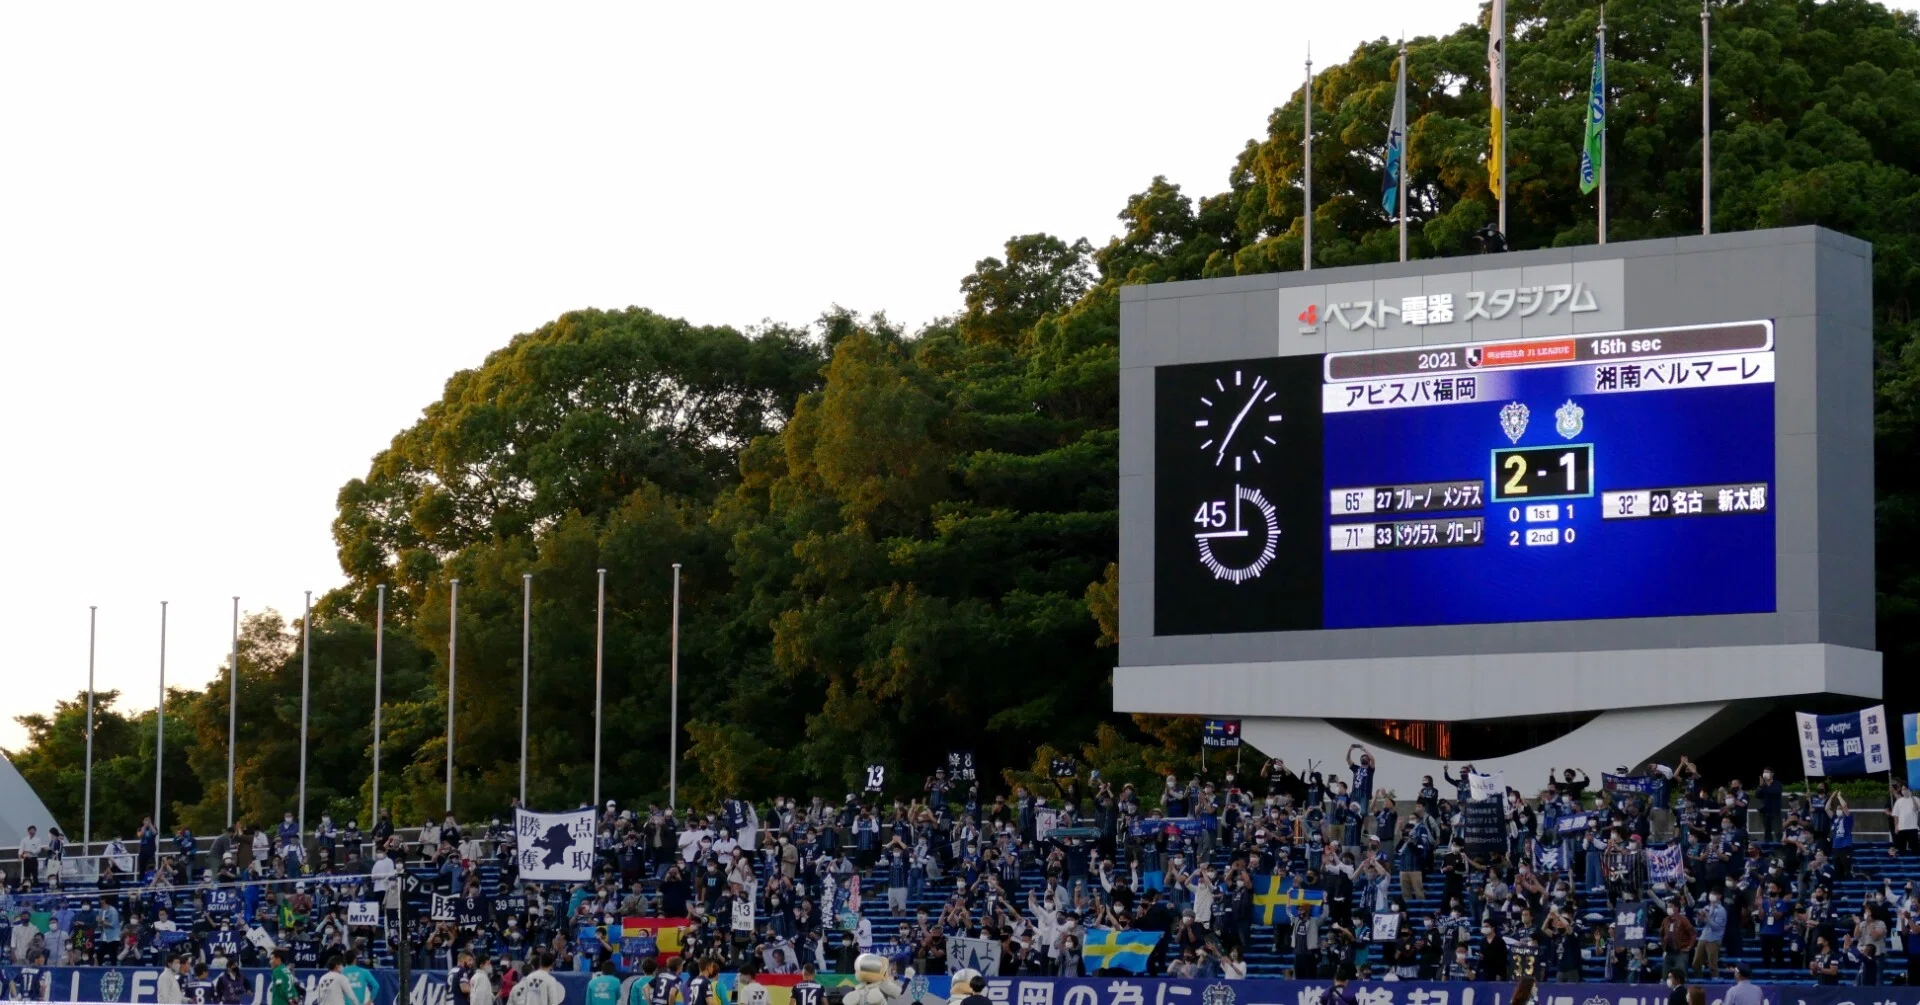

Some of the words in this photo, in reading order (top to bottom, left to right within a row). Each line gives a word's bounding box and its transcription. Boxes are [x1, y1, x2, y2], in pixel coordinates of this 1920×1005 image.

[1322, 293, 1453, 331] ベスト電器
[1463, 281, 1599, 322] スタジアム
[1591, 338, 1626, 355] 15th
[1631, 338, 1662, 351] sec
[1418, 352, 1457, 369] 2021
[1596, 357, 1761, 390] 湘南ベルマーレ
[1345, 376, 1476, 407] アビスパ福岡
[1504, 454, 1528, 494] 2
[1559, 452, 1575, 491] 1
[1345, 491, 1364, 511] 65'
[1376, 492, 1392, 509] 27
[1395, 487, 1432, 510] ブルーノ
[1619, 495, 1638, 514] 32'
[1652, 495, 1668, 512] 20
[1672, 490, 1703, 514] 名古
[1718, 487, 1765, 511] 新太郎
[1194, 501, 1226, 527] 45
[1509, 507, 1520, 522] 0
[1533, 508, 1551, 519] 1st
[1566, 504, 1574, 519] 1
[1345, 528, 1364, 547] 71'
[1376, 527, 1392, 545] 33
[1395, 522, 1438, 546] ドウグラス
[1446, 520, 1482, 543] グローリ
[1509, 530, 1519, 545] 2
[1531, 531, 1553, 543] 2nd
[1564, 528, 1575, 543] 0
[1228, 725, 1235, 735] 3
[1821, 736, 1862, 756] 福岡
[964, 753, 972, 767] 8
[867, 764, 884, 787] 13
[519, 815, 540, 837] 勝
[573, 817, 592, 838] 点
[520, 849, 539, 871] 奪
[571, 850, 591, 871] 取
[210, 891, 226, 903] 19
[466, 898, 474, 910] 6
[495, 900, 507, 911] 39
[360, 904, 367, 912] 5
[350, 914, 375, 923] MIYA
[460, 914, 482, 924] Mae
[217, 931, 232, 942] 11
[195, 987, 205, 1004] 8
[657, 978, 667, 998] 3
